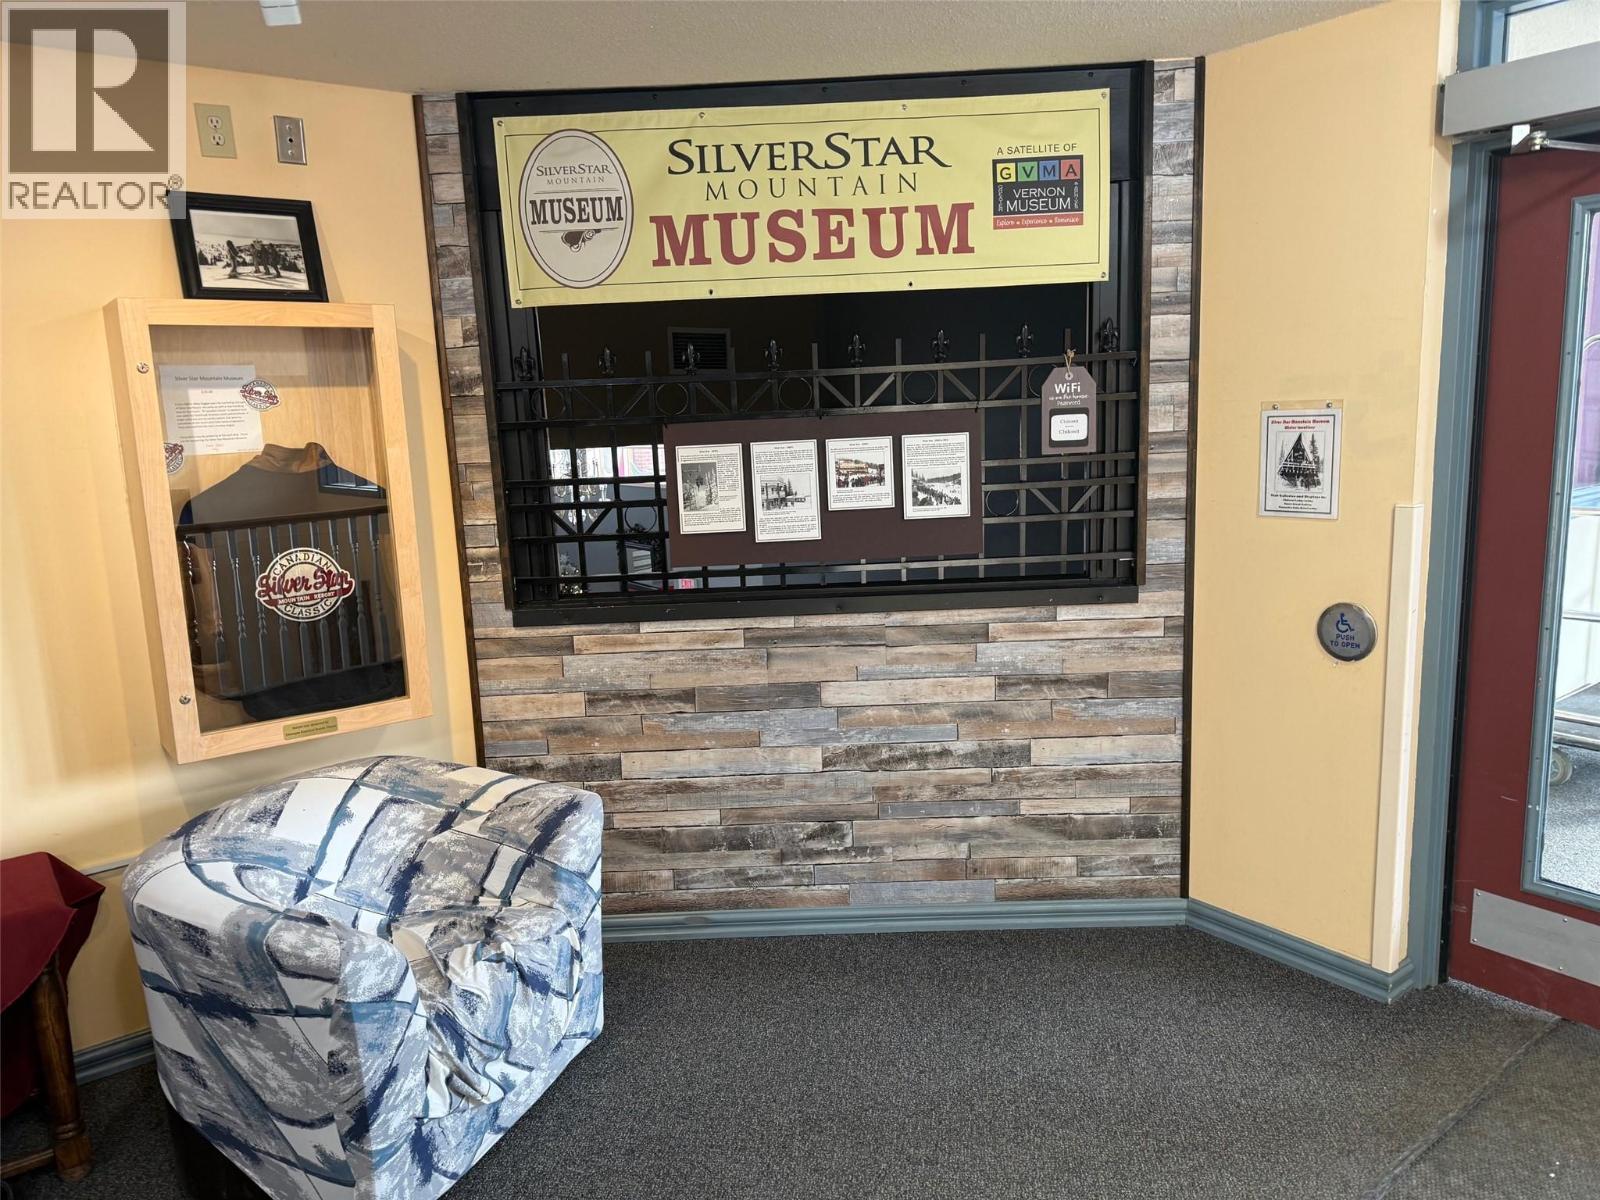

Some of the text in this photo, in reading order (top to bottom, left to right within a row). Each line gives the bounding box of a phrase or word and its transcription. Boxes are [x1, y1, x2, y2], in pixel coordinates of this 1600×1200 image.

[997, 143, 1077, 155] A SATELLITE OF
[546, 176, 605, 185] MOUNTAIN
[705, 172, 917, 201] MOUNTAIN
[1013, 187, 1066, 198] VERNON
[529, 196, 623, 225] MUSEUM
[1006, 197, 1071, 212] MUSEUM
[649, 202, 975, 268] MUSEUM
[1054, 382, 1081, 394] WiFi
[272, 552, 332, 576] CANADIAN
[257, 567, 349, 598] Silver Star
[278, 591, 335, 604] MOUNTAIN RESORT
[284, 599, 332, 616] CLASSIC
[1335, 633, 1355, 641] PUSH
[1341, 641, 1361, 649] OPEN
